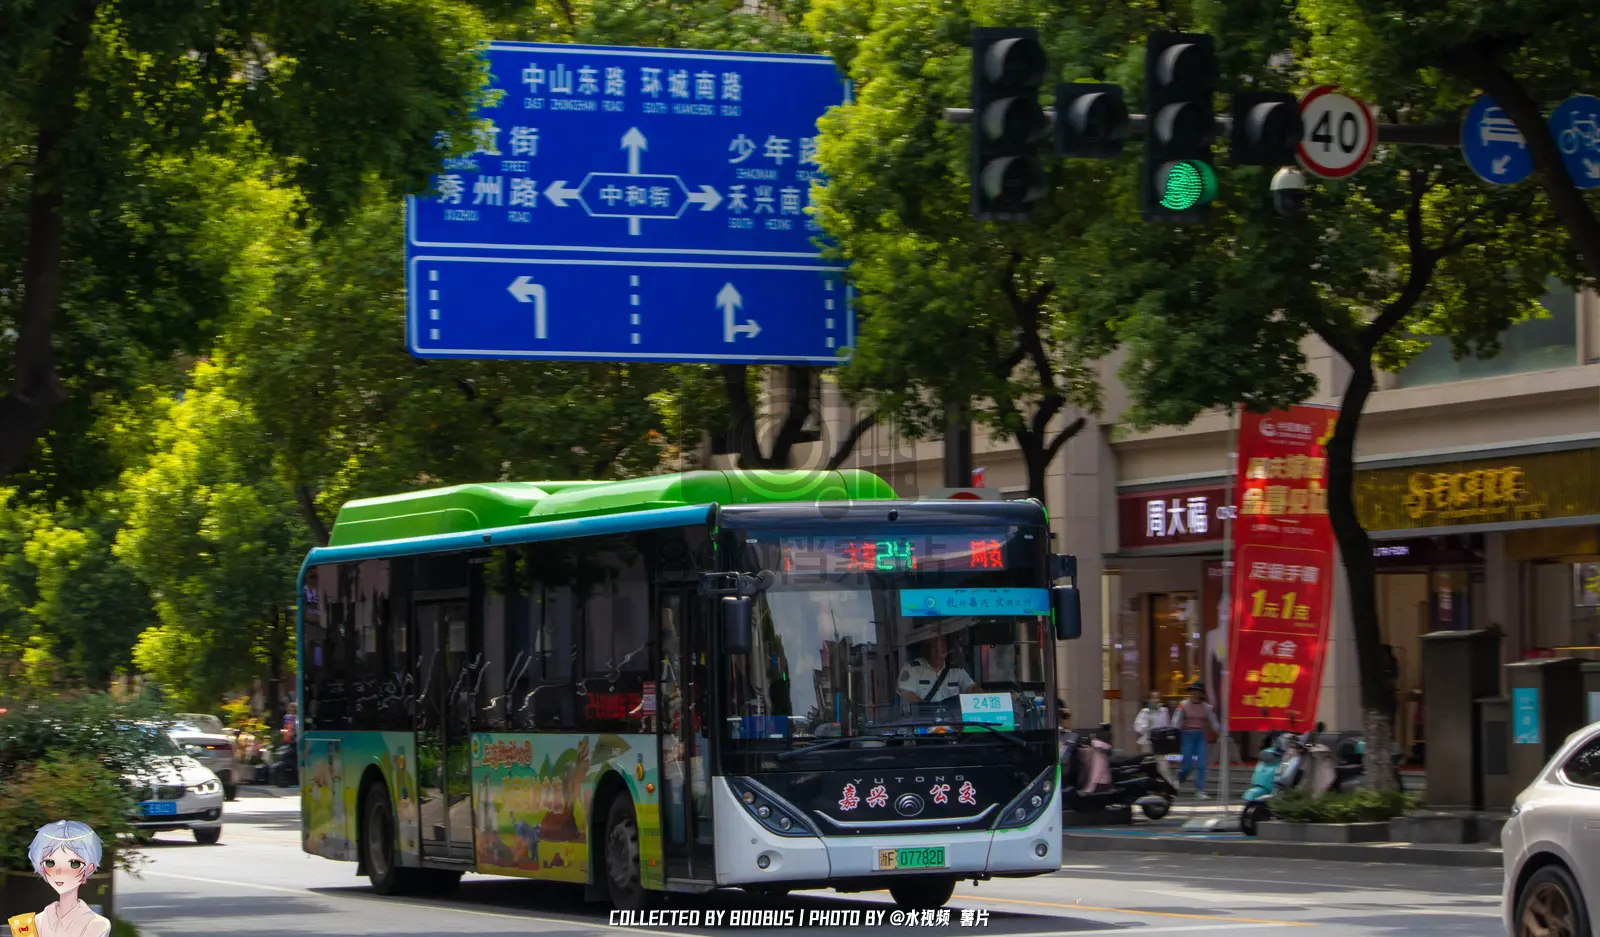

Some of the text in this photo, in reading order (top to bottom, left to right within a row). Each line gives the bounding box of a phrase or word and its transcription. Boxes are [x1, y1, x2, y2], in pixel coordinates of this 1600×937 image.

[522, 62, 743, 101] 中山东路 环城南路
[1311, 110, 1358, 153] 40
[435, 174, 539, 208] 秀州路
[599, 184, 672, 207] 中和街
[727, 184, 810, 215] 禾兴南
[1146, 497, 1208, 537] 周大福
[876, 541, 912, 570] 24
[1260, 640, 1297, 658] K金
[973, 696, 1001, 709] 24路
[854, 775, 964, 784] YUTONG
[839, 781, 976, 811] 嘉兴 公交
